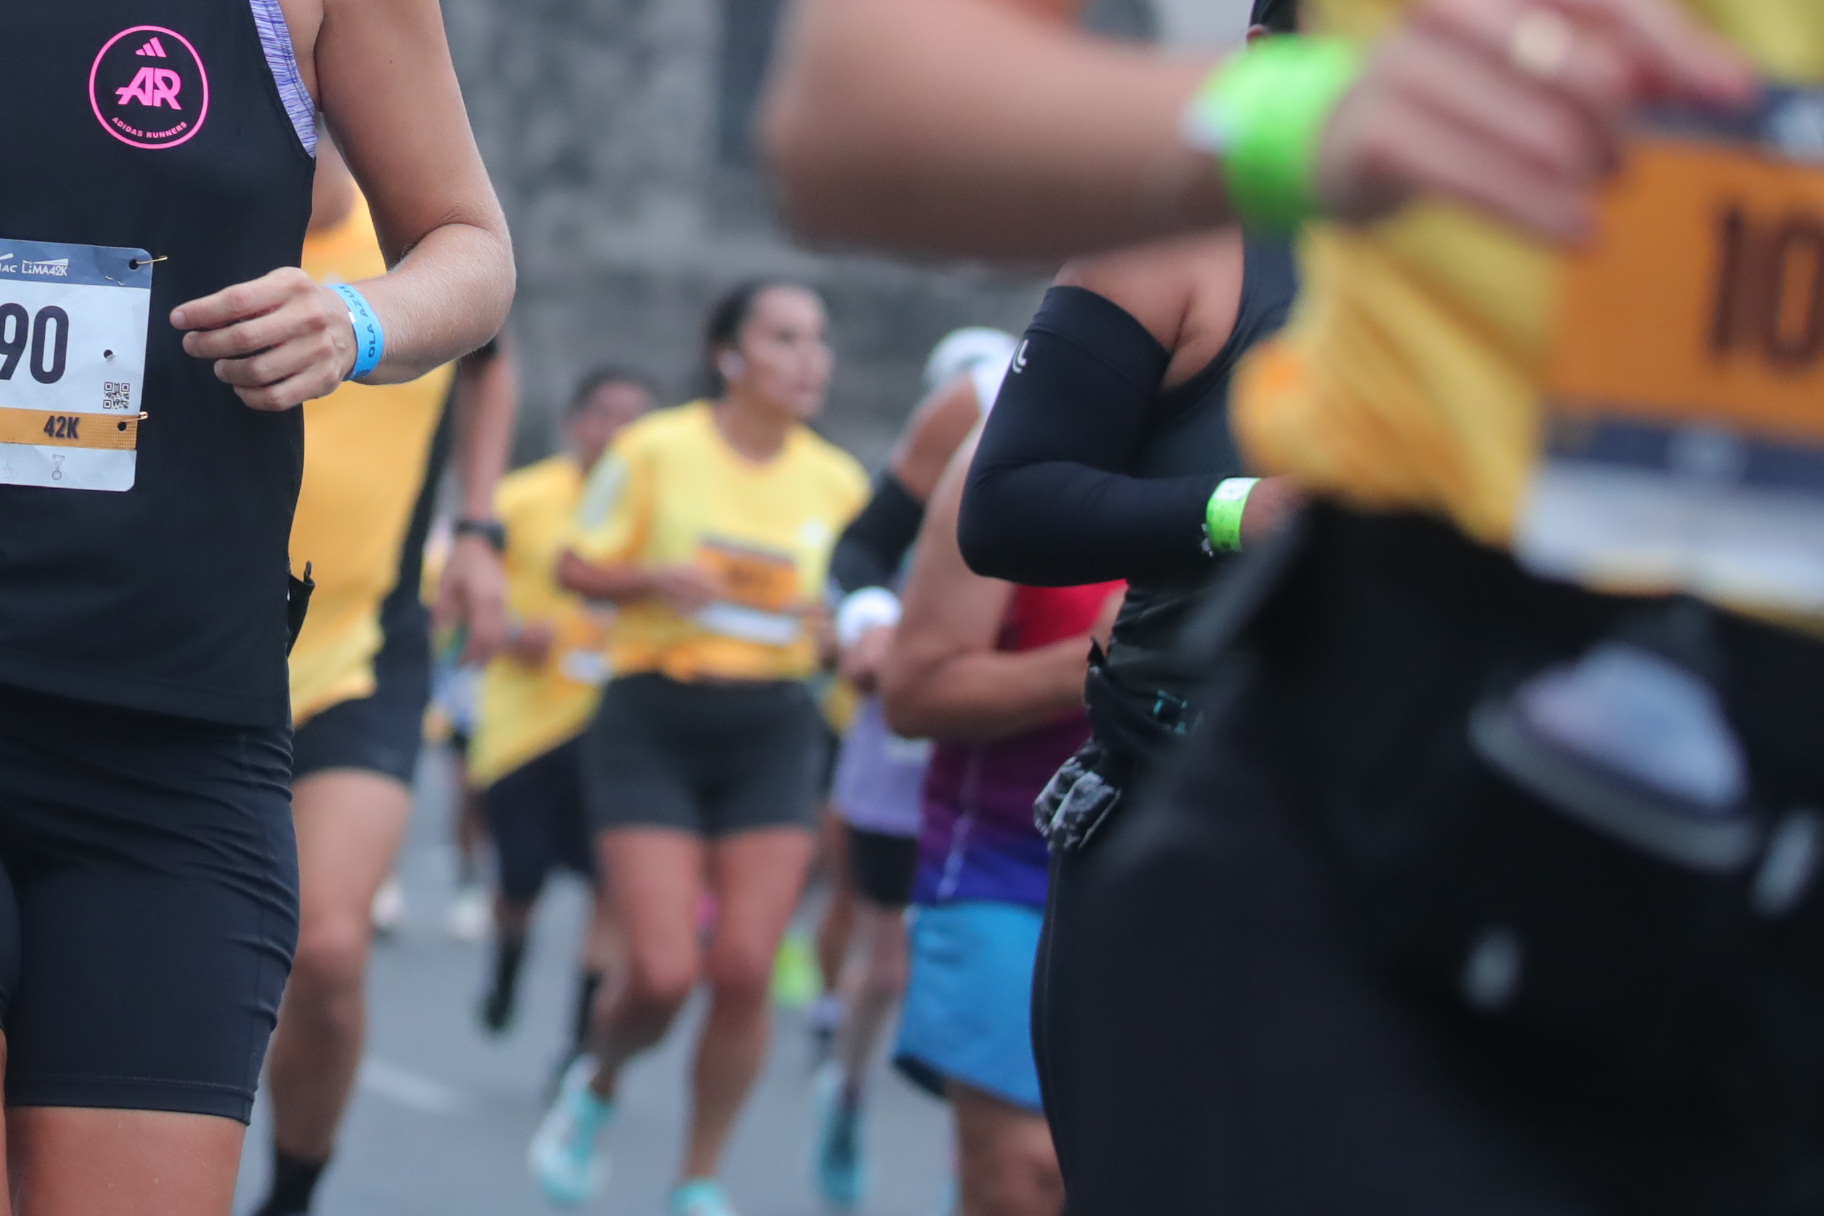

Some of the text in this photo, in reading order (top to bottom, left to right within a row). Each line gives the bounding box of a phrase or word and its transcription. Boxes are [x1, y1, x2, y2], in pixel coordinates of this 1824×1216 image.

[115, 66, 182, 111] AR
[112, 117, 188, 138] ADIDAS RUNNERS
[367, 322, 376, 358] OLA
[43, 415, 80, 439] 42K
